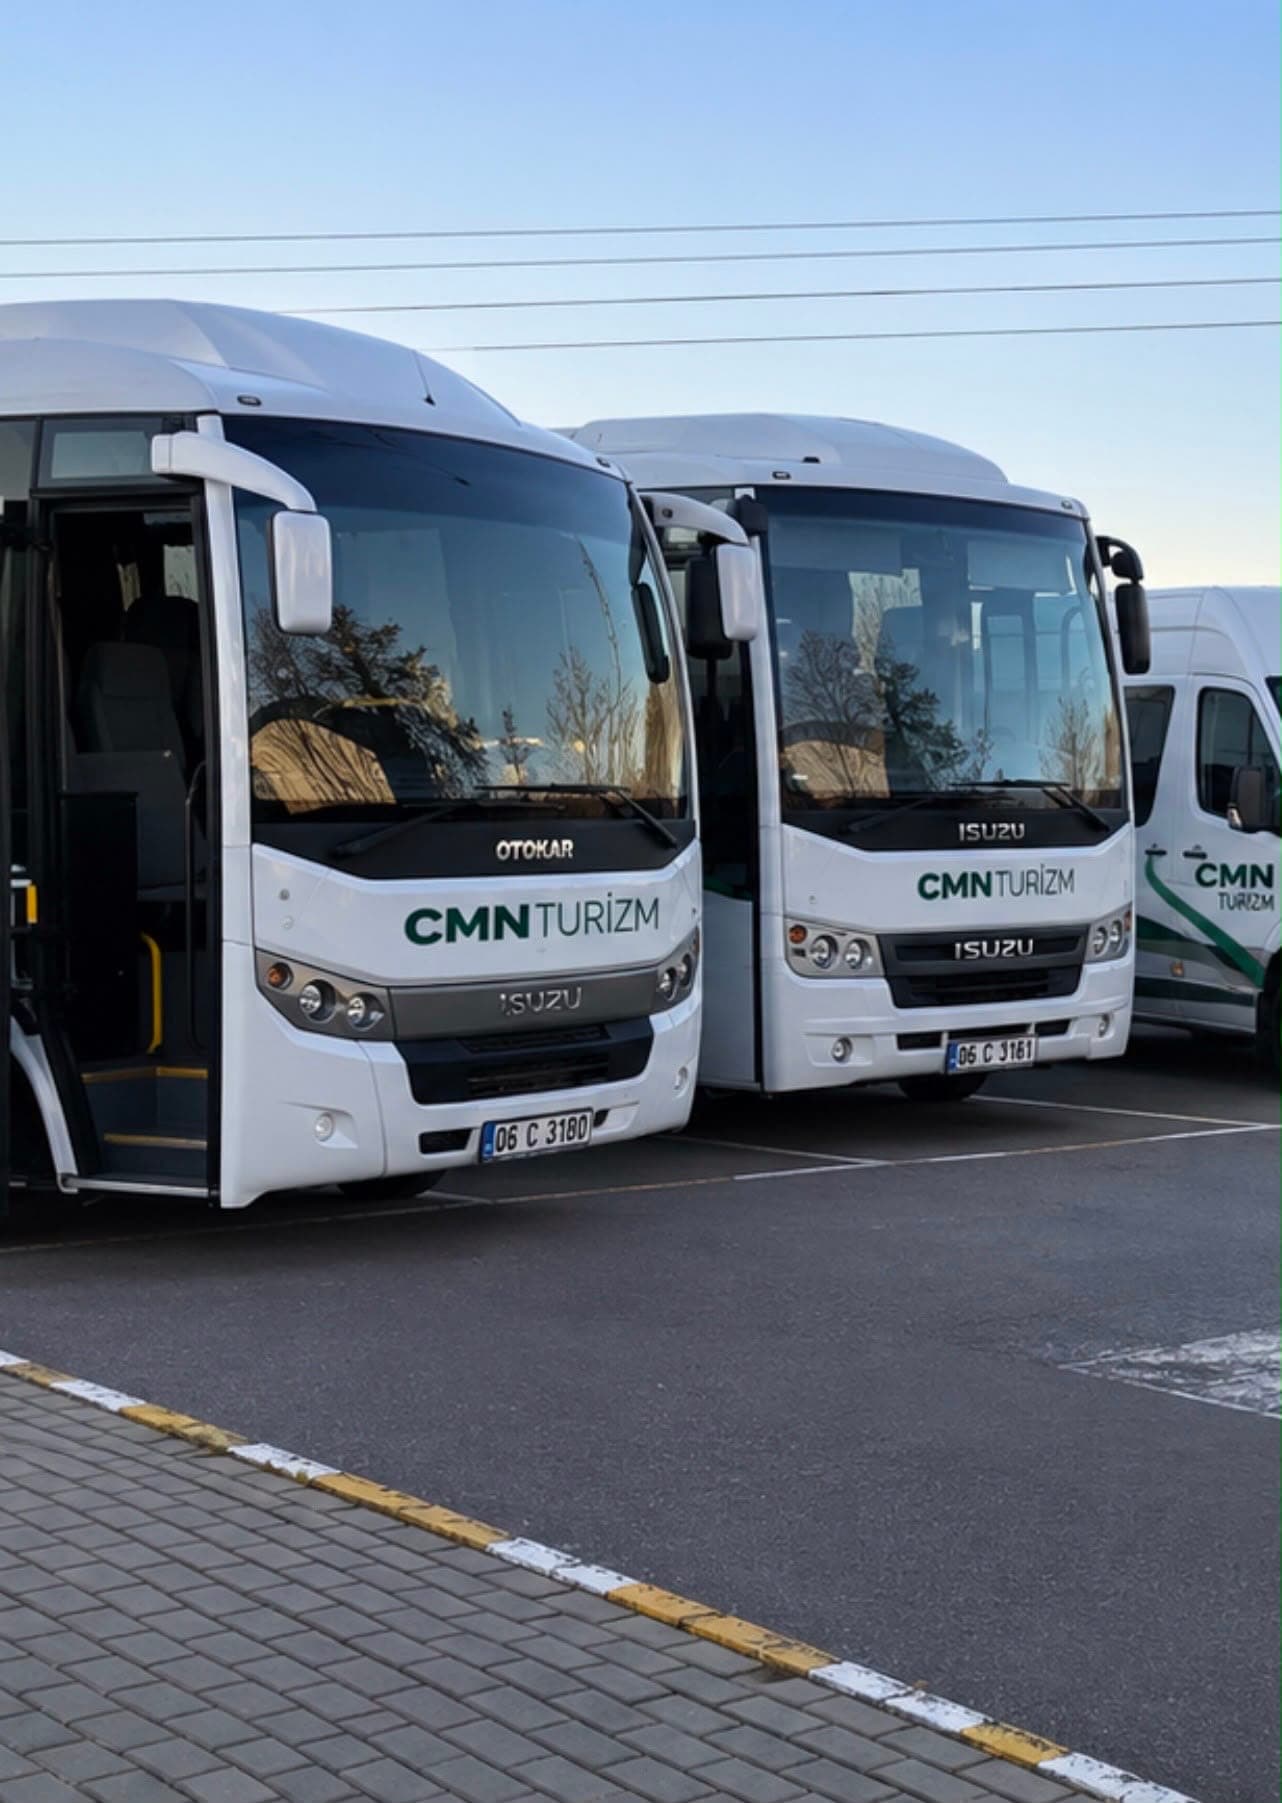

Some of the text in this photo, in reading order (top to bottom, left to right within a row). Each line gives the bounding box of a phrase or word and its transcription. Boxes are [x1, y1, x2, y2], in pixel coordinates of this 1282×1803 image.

[958, 822, 1025, 842] ISUZU
[496, 839, 574, 860] OTOKAR
[917, 870, 992, 901] CMN
[1195, 863, 1274, 888] CMN
[404, 904, 530, 946] CMN
[954, 938, 1034, 960] ISUZU
[500, 987, 583, 1015] ISUZU
[959, 1045, 976, 1065] 06
[983, 1043, 993, 1063] C
[496, 1114, 588, 1153] 06 C 3180
